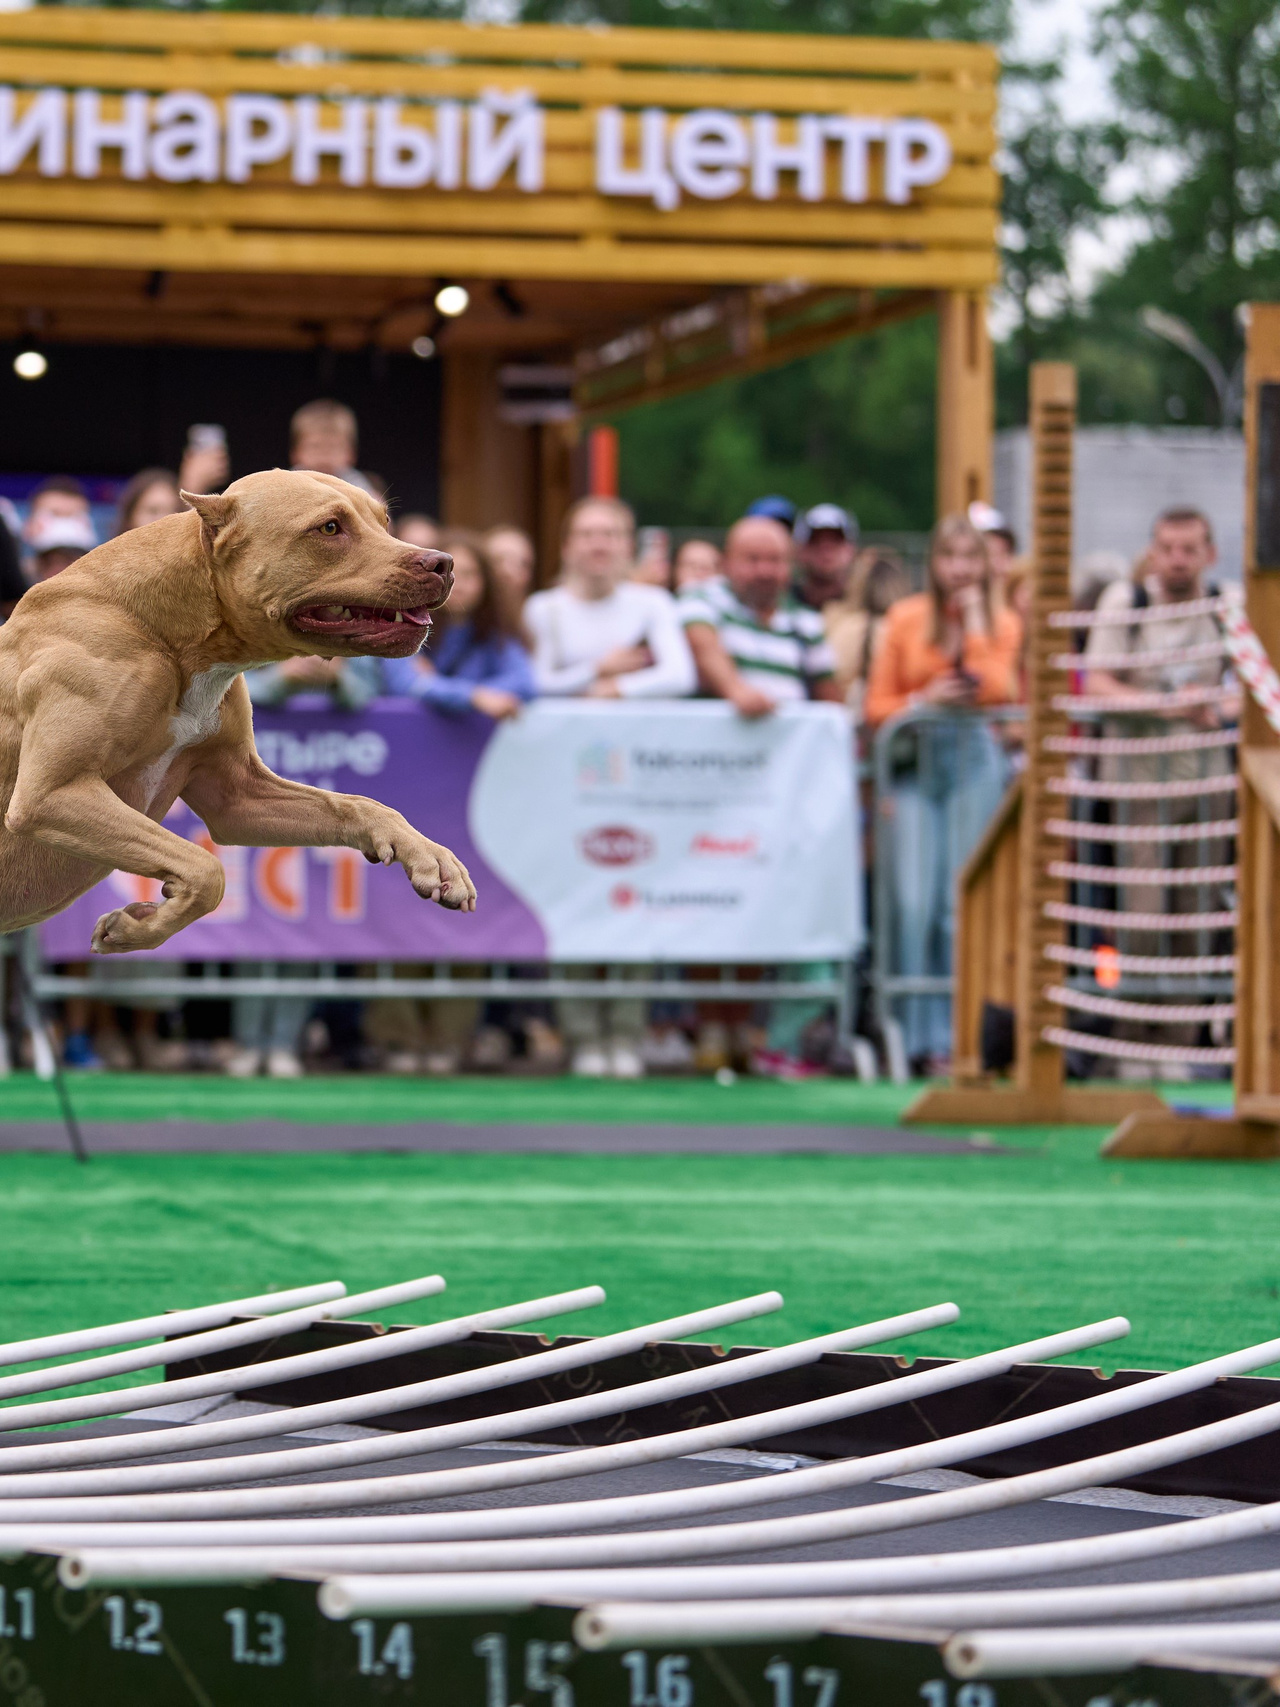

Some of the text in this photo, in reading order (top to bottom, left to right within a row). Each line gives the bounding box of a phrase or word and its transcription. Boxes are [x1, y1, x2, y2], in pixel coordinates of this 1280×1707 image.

[594, 106, 953, 210] центр
[104, 1596, 162, 1655] 1.2
[225, 1608, 284, 1665] 1.3
[352, 1619, 413, 1679] 1.4
[474, 1632, 574, 1707] 15
[765, 1658, 839, 1707] 17
